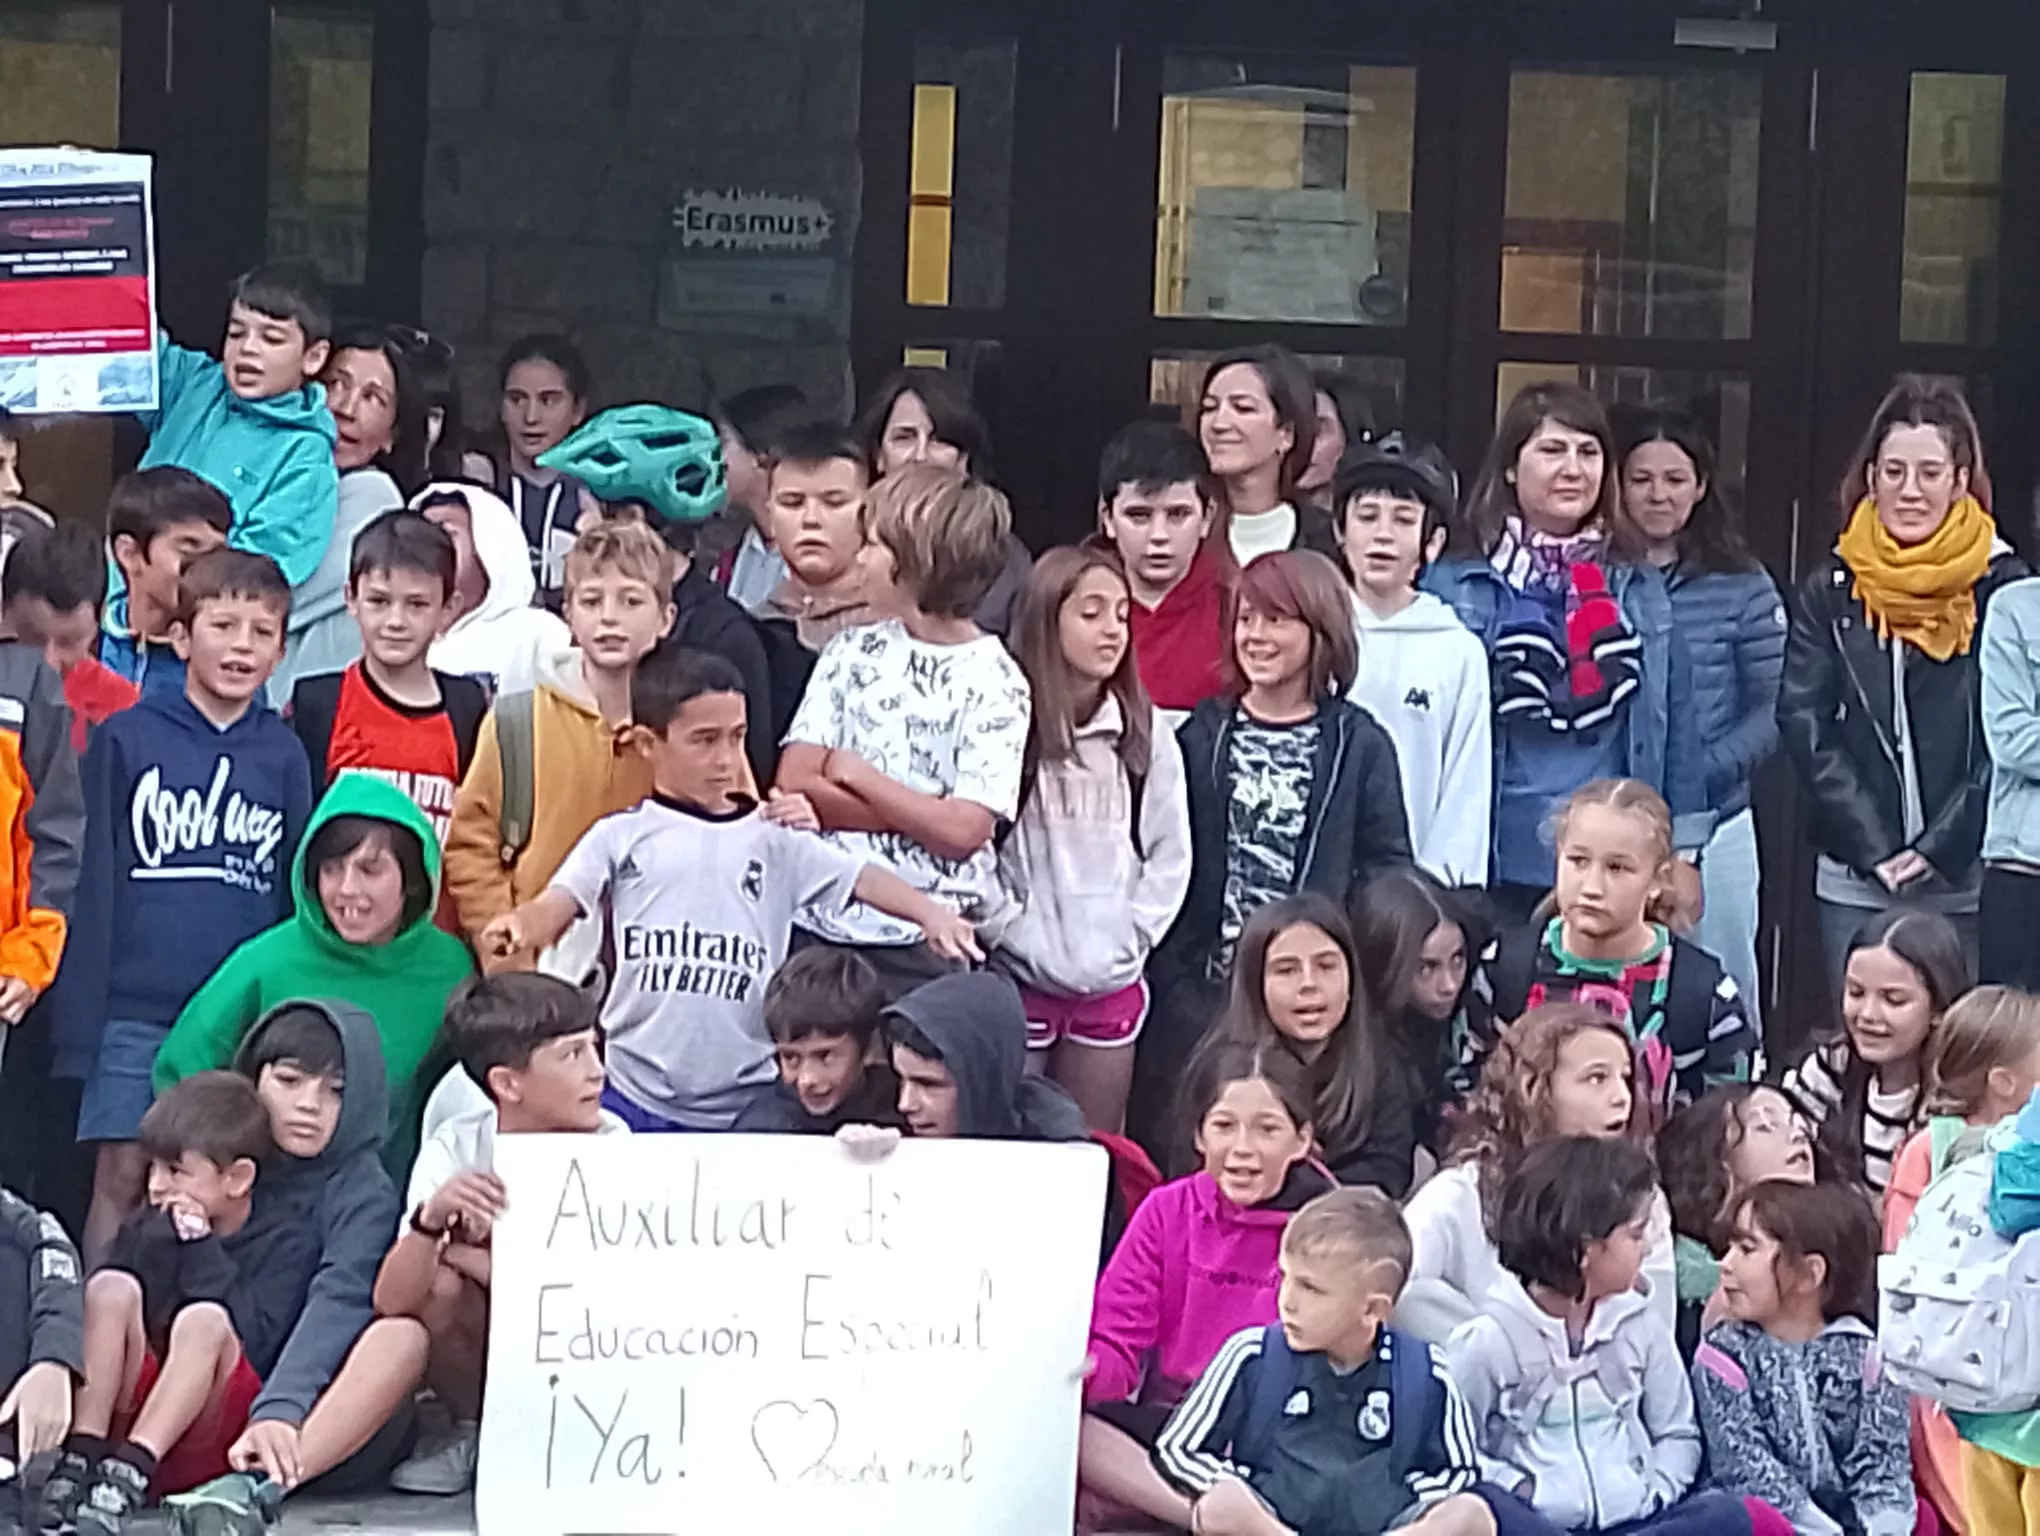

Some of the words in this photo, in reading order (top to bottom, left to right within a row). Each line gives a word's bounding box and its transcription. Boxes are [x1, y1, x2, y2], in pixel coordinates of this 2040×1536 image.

[686, 206, 827, 236] Erasmus+
[132, 756, 230, 868] Cool
[624, 920, 767, 974] Emirates
[676, 963, 752, 1003] BETTER
[546, 1157, 796, 1251] Auxiliar
